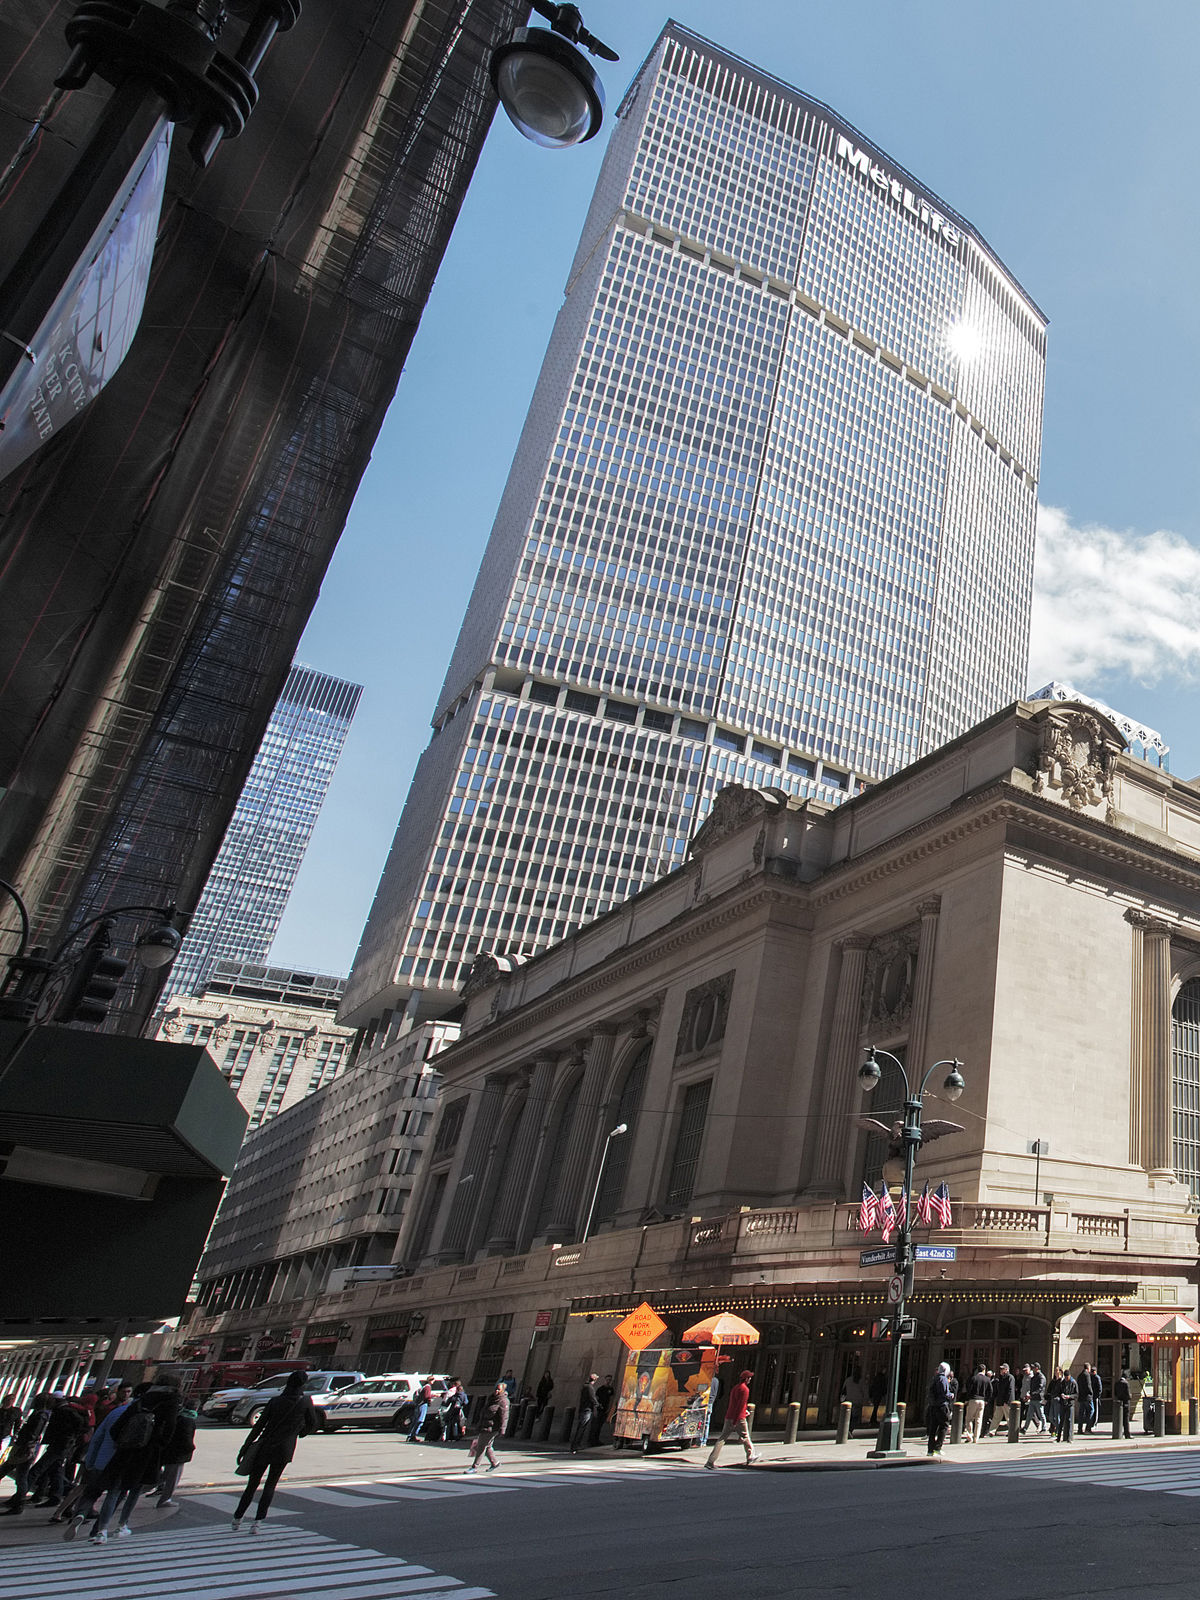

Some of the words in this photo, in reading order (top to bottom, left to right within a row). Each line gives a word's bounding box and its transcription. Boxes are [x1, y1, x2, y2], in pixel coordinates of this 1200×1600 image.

[837, 133, 959, 247] MetLife
[862, 1252, 886, 1263] Vanderbilt
[886, 1251, 896, 1259] Ave
[915, 1249, 928, 1257] East
[929, 1249, 945, 1257] 42nd
[946, 1250, 954, 1258] St
[257, 1340, 273, 1348] STOP
[335, 1400, 403, 1410] POLICE
